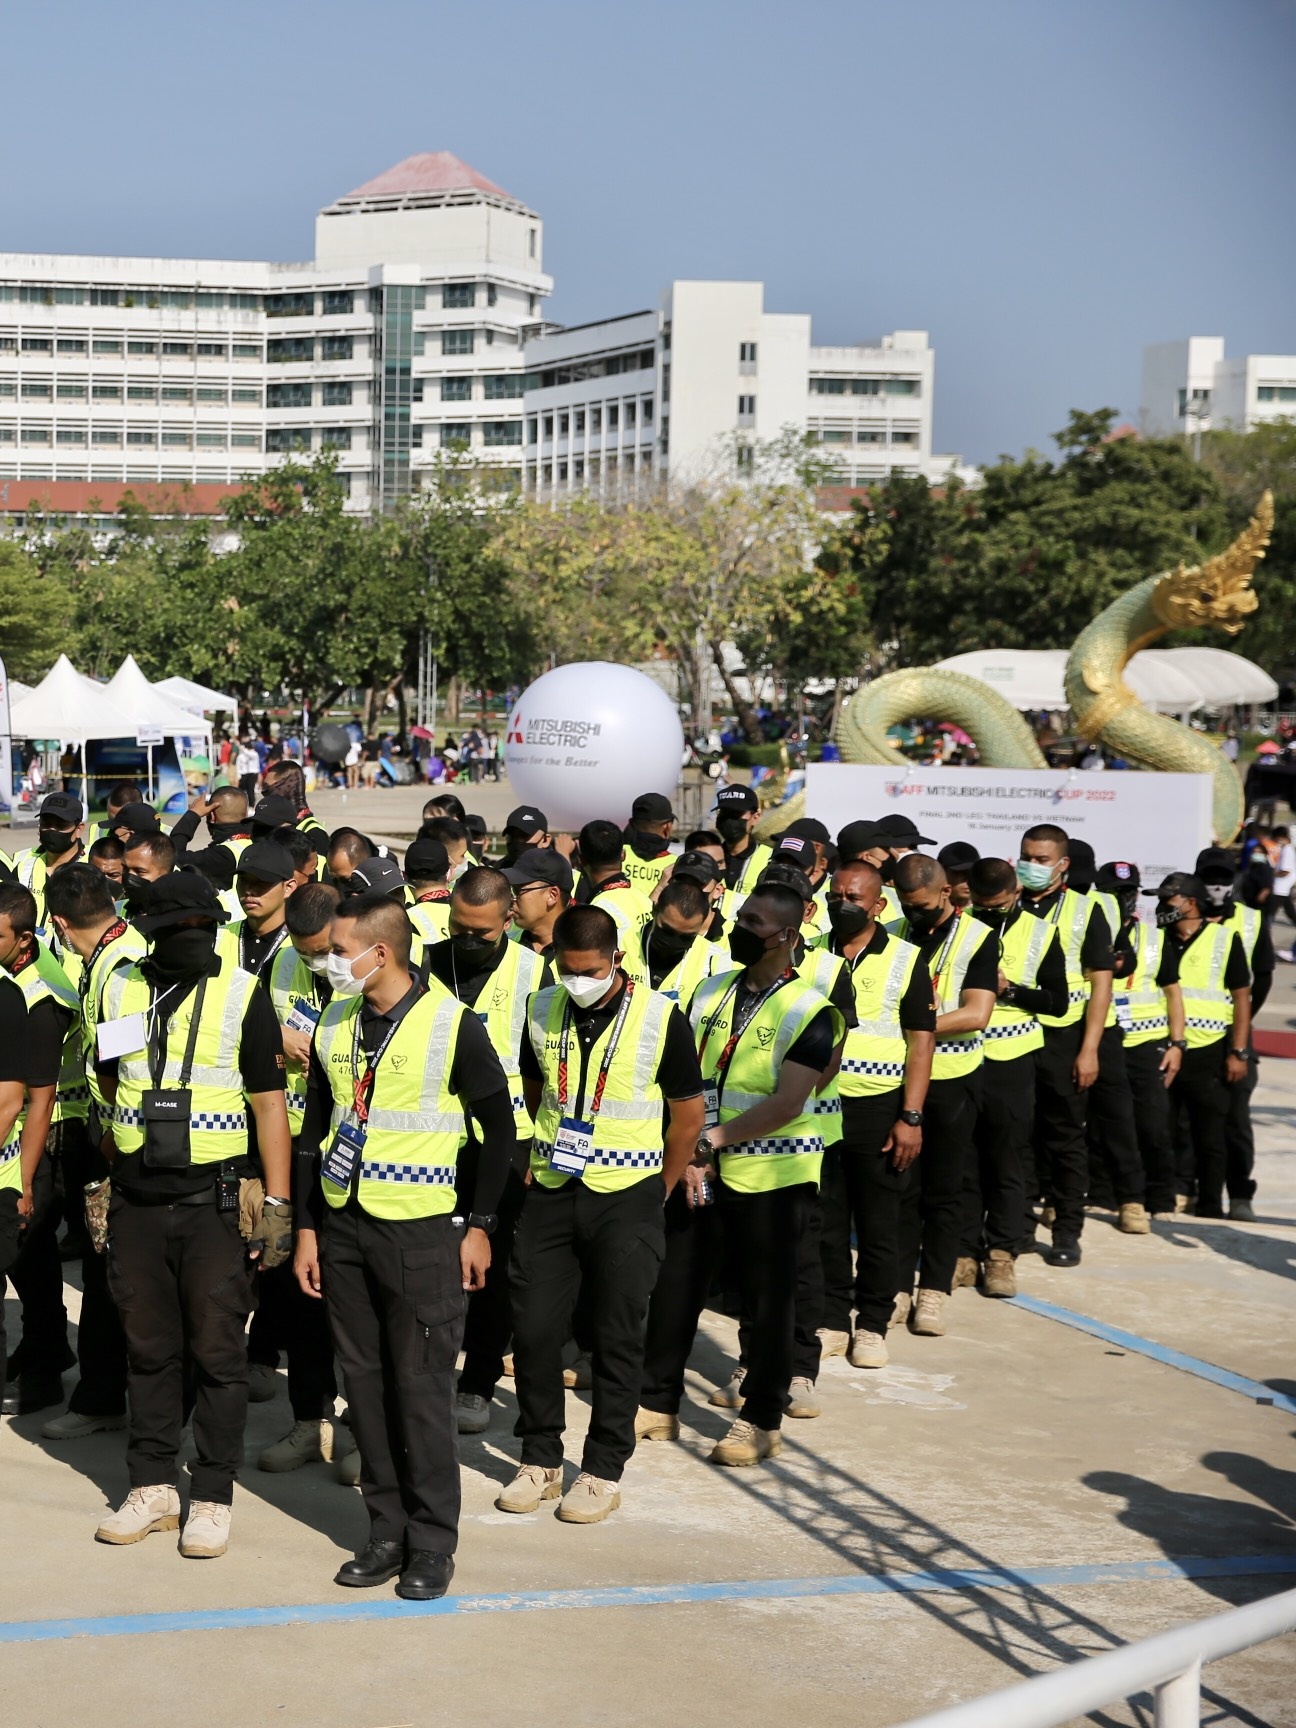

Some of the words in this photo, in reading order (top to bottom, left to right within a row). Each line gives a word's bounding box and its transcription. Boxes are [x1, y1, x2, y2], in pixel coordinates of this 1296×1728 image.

[527, 719, 601, 736] MITSUBISHI
[526, 732, 588, 749] ELECTRIC
[529, 755, 545, 766] for
[545, 756, 562, 767] the
[564, 756, 600, 768] Better
[902, 784, 923, 795] AFF
[926, 785, 993, 797] MITSUBISHI
[995, 786, 1054, 799] ELECTRIC
[1055, 787, 1084, 800] CUP
[625, 864, 661, 882] SECUR
[577, 1138, 589, 1148] FA
[557, 1165, 576, 1174] SECURITY
